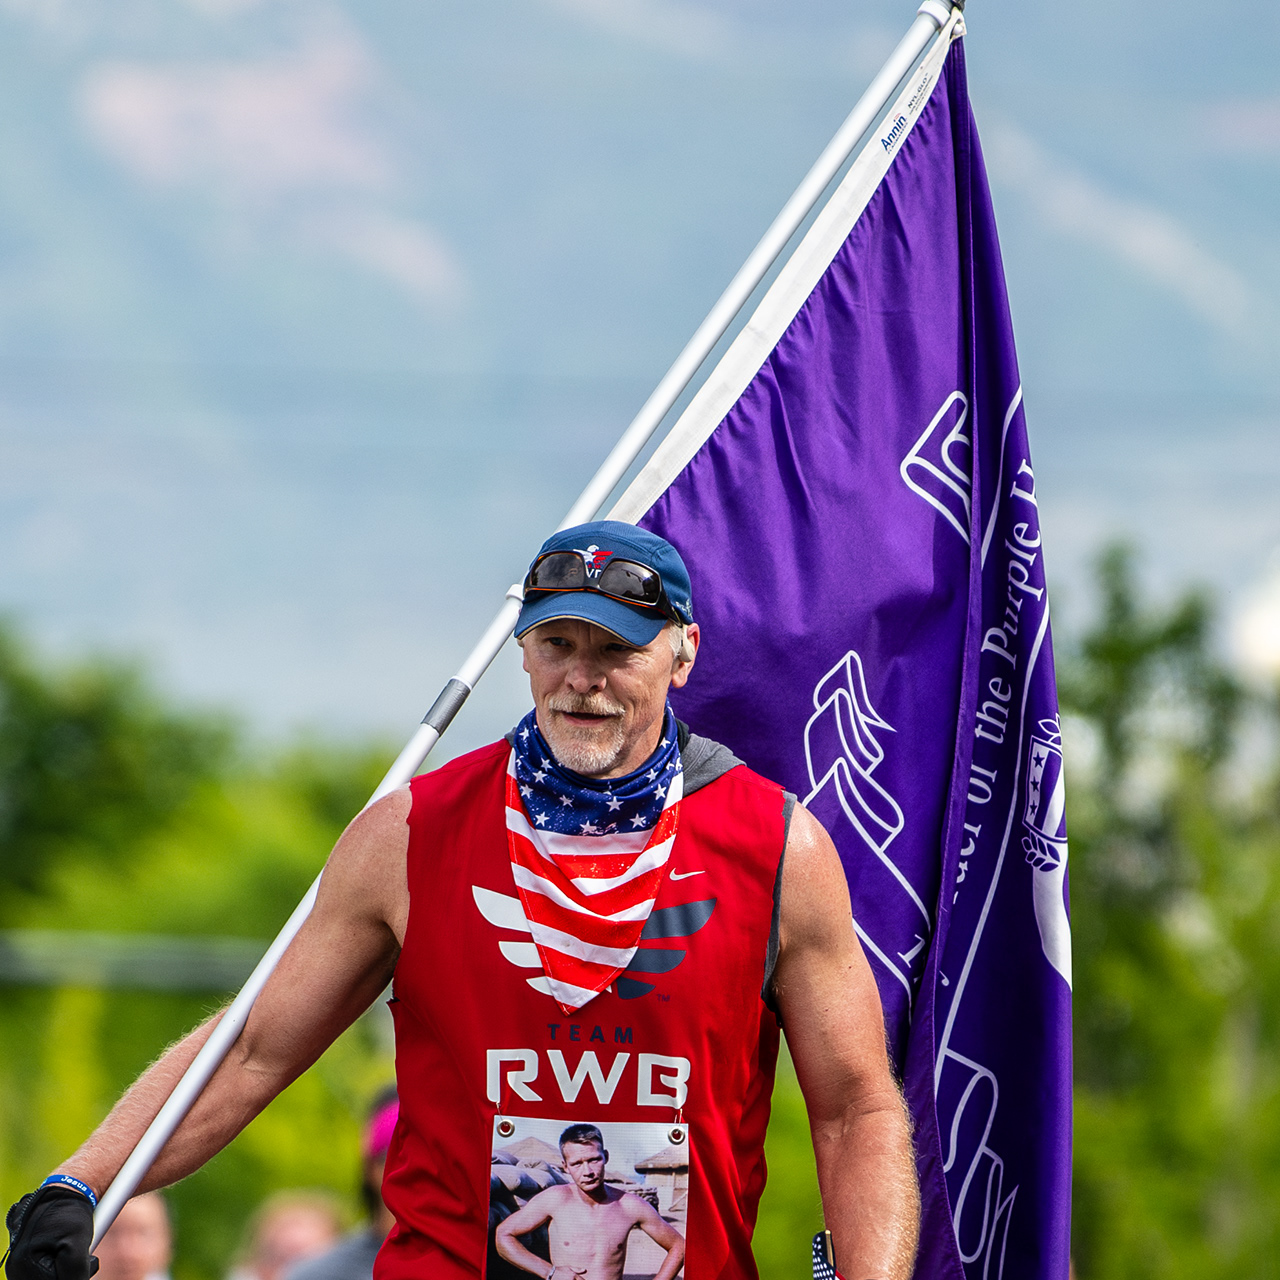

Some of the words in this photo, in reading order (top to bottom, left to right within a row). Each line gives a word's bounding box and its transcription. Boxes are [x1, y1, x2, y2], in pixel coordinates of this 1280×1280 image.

[880, 115, 907, 151] Annin
[980, 521, 1045, 671] Purple
[974, 677, 1013, 745] the
[547, 1023, 634, 1044] TEAM
[486, 1048, 691, 1110] RWB
[60, 1175, 88, 1192] Jesus
